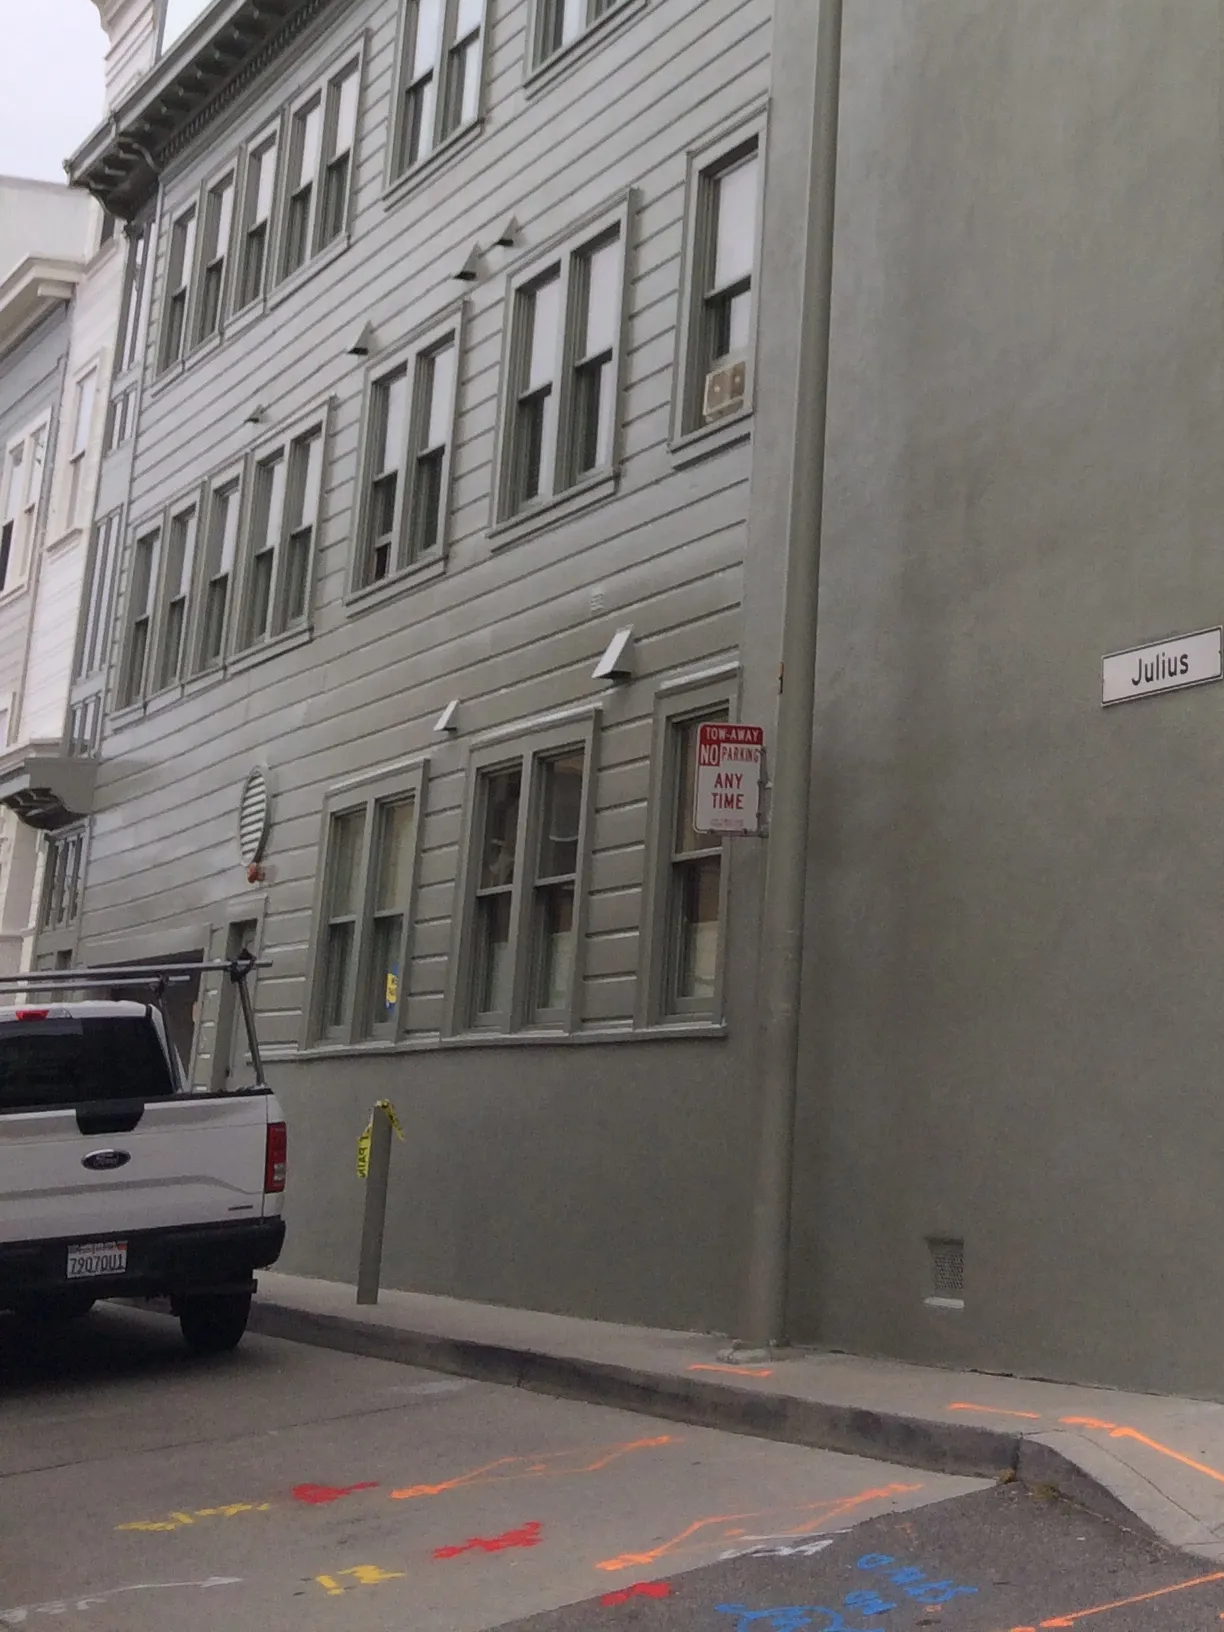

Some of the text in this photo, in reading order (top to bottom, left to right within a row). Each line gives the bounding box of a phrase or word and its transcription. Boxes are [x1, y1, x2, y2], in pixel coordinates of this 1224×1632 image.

[1132, 652, 1189, 686] Julius
[706, 727, 759, 741] TOW-AWAY
[700, 744, 759, 765] NO PARKING
[714, 773, 743, 789] ANY
[711, 792, 744, 809] TIME
